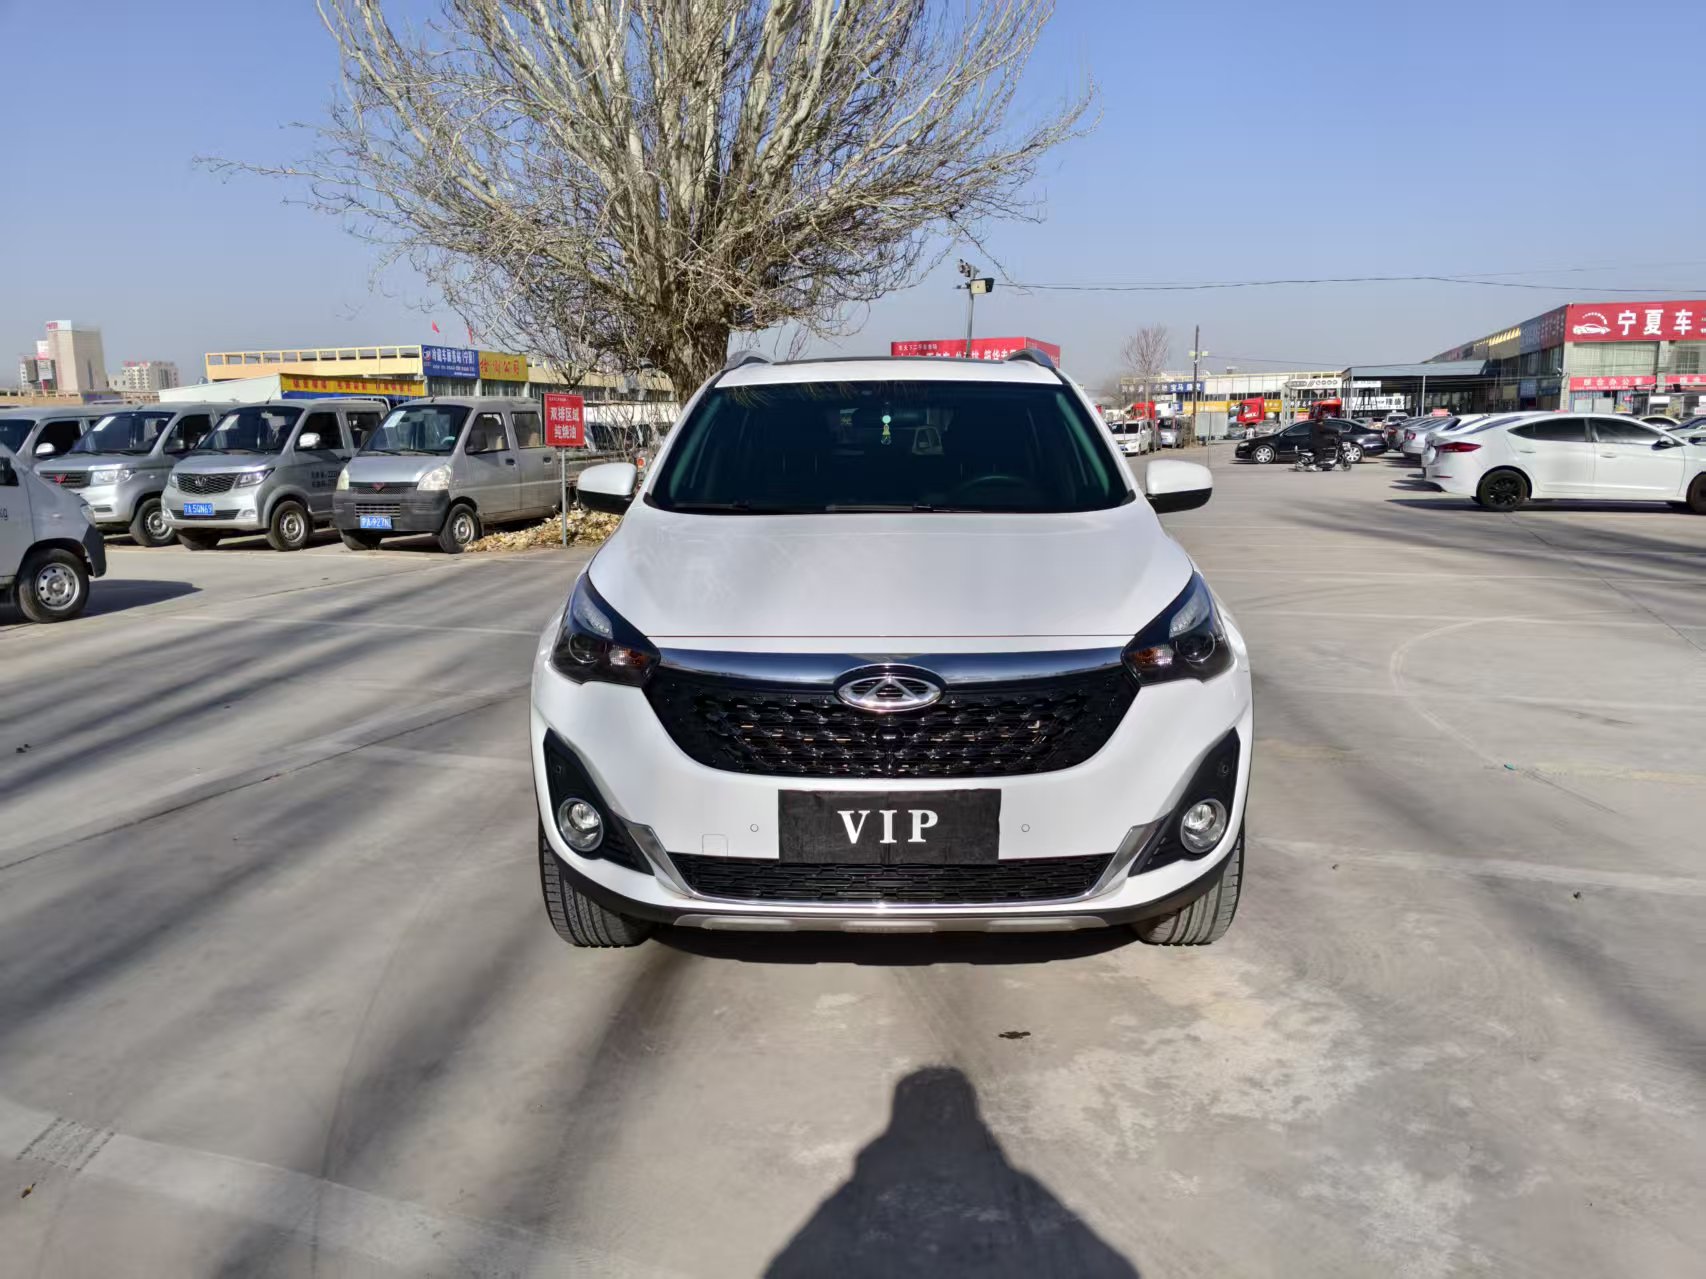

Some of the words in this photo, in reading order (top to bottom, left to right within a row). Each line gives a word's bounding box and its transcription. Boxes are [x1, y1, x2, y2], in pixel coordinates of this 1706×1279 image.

[1618, 308, 1706, 336] 宁夏车
[550, 407, 580, 421] 双排区域
[837, 809, 939, 845] VIP
